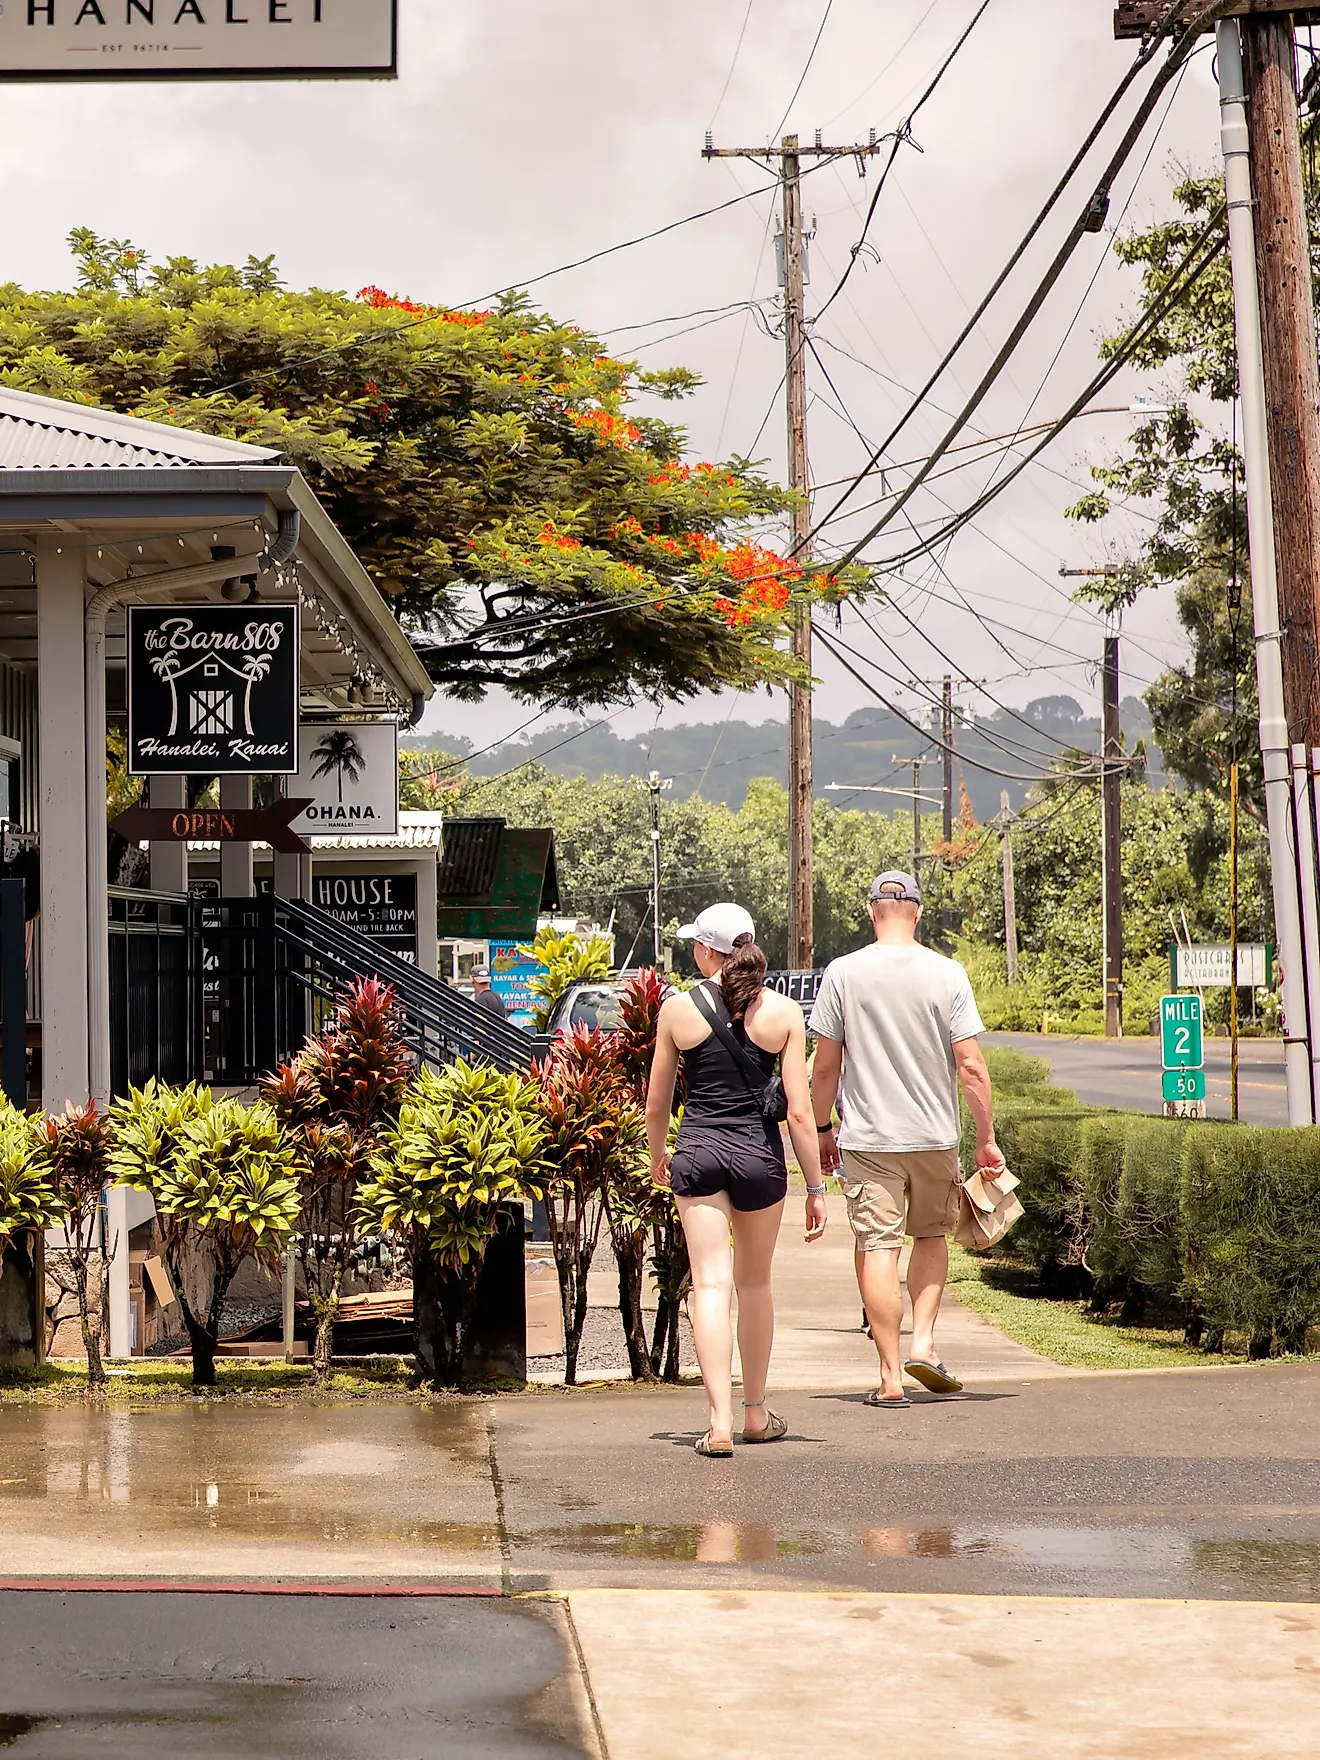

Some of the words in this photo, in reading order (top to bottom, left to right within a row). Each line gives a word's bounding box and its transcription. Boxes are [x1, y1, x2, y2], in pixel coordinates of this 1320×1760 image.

[26, 0, 322, 25] HANALEI
[137, 737, 221, 758] Hanalei,
[227, 737, 289, 762] Kauai
[171, 812, 236, 839] OPEN
[318, 878, 394, 905] HOUSE
[370, 924, 383, 932] THE
[386, 924, 404, 932] BACK
[1184, 950, 1244, 965] POSTCARS
[1184, 968, 1230, 979] RESTAURAN
[506, 1001, 547, 1009] RENTALS
[1165, 1002, 1199, 1021] MILE
[1174, 1027, 1190, 1054] 2
[1171, 1078, 1196, 1093] .50
